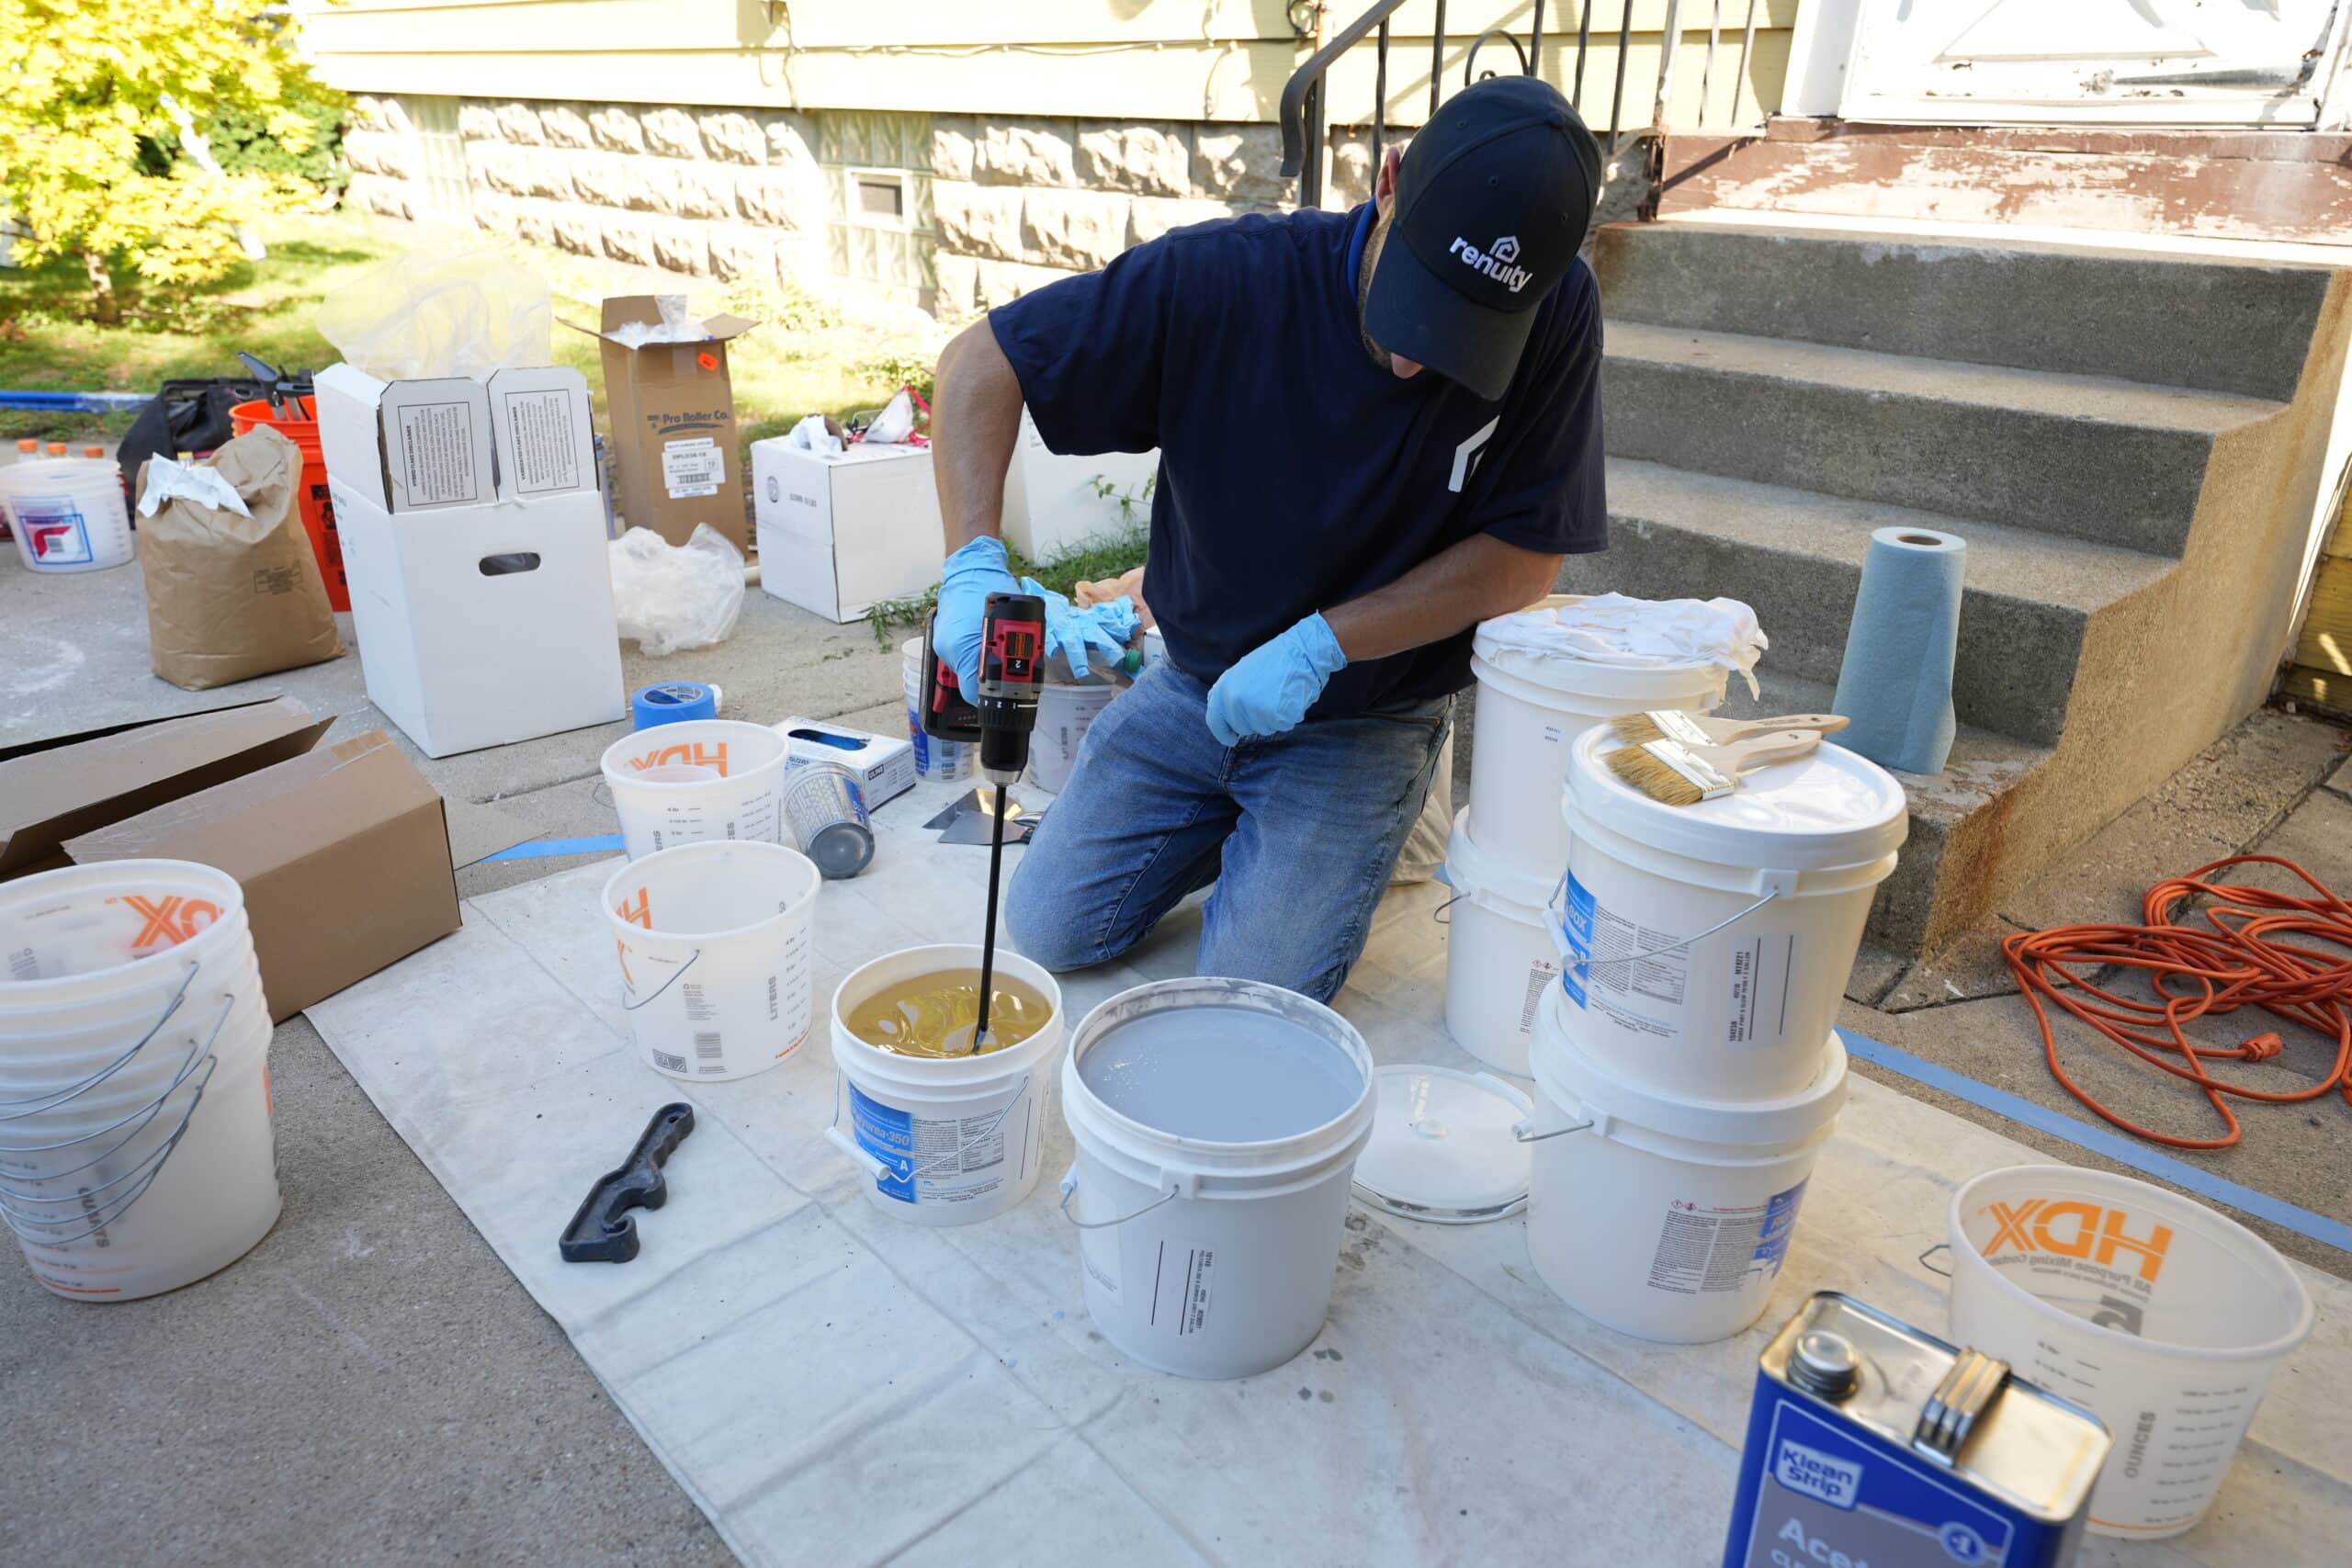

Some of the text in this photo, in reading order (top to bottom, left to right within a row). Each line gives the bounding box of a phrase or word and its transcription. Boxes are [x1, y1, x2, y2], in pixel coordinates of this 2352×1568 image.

[1449, 236, 1533, 292] renuity
[662, 413, 681, 423] Pro
[683, 412, 711, 423] Roller
[1015, 660, 1022, 669] 2
[768, 976, 778, 1021] LITERS
[899, 1159, 909, 1171] A
[2123, 1411, 2156, 1479] OUNCES
[1782, 1448, 1853, 1485] Klean
[1787, 1465, 1842, 1497] Strip
